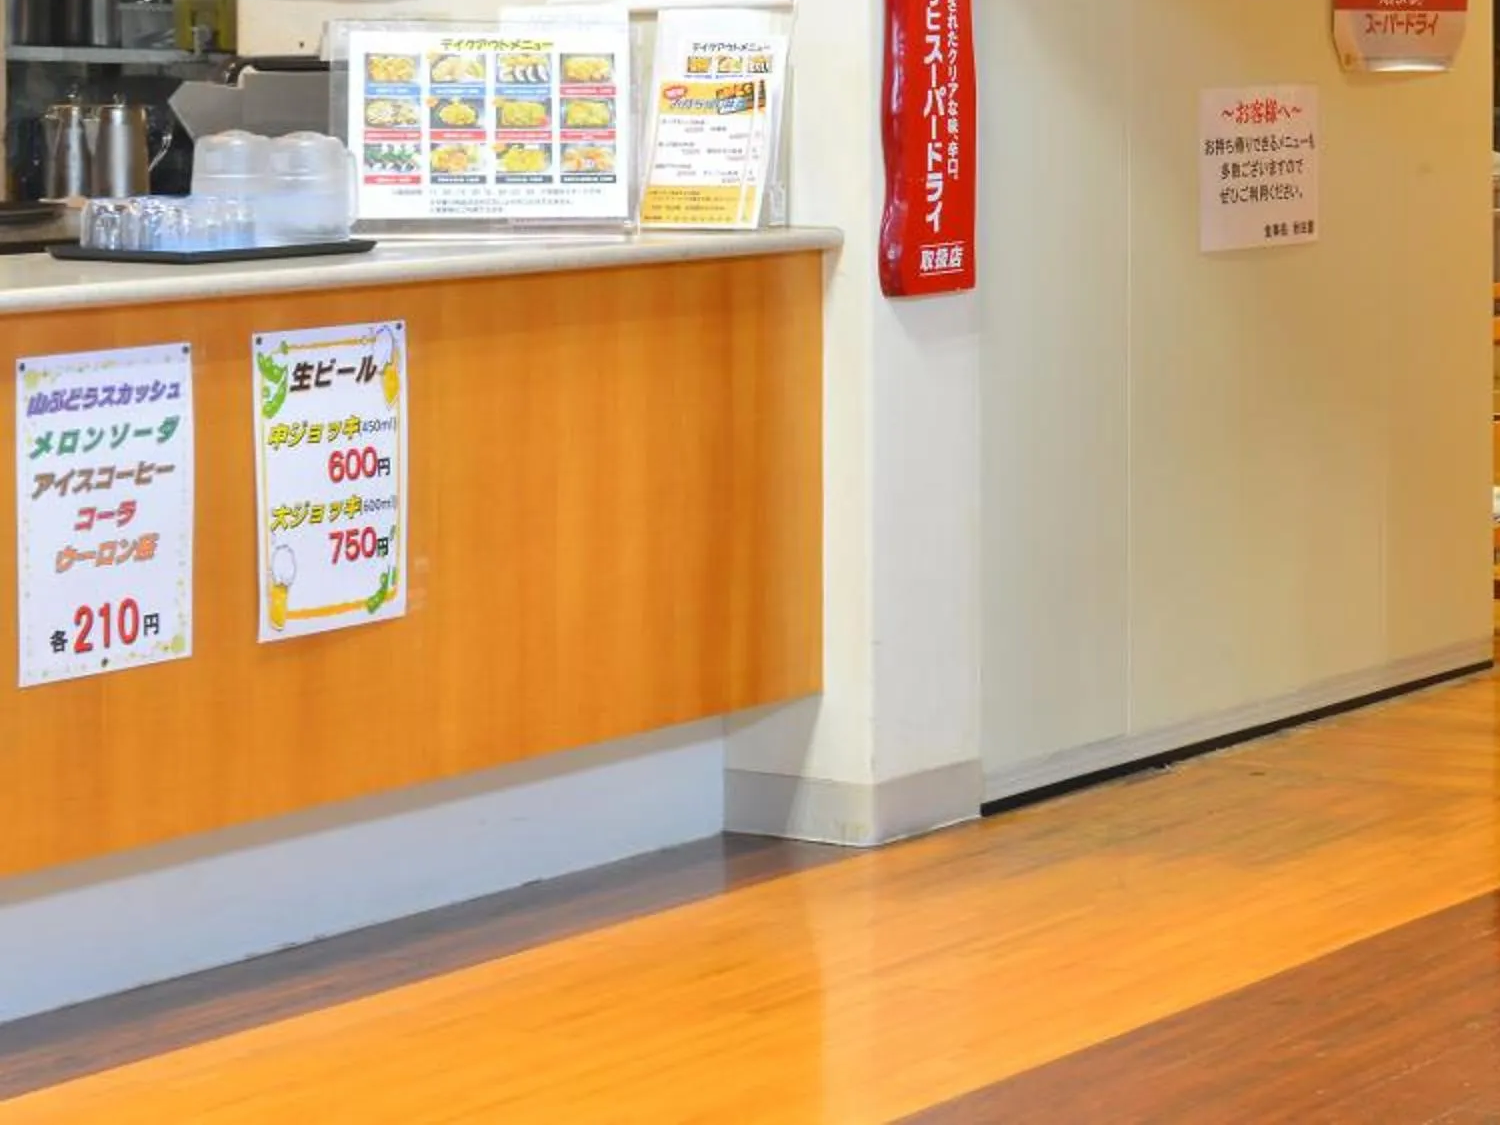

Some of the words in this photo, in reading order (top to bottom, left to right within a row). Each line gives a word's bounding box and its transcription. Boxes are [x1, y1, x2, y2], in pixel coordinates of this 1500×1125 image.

[1365, 14, 1438, 36] スーパードライ
[920, 246, 964, 271] 取扱店
[289, 355, 378, 392] 生ビール
[27, 381, 181, 417] 山ぶどうスカッシュ
[30, 416, 181, 459] メロンソーダ
[32, 460, 175, 499] アイスコーヒー
[327, 446, 390, 483] 600円
[74, 500, 136, 531] コーラ
[55, 533, 159, 574] ウーロン茶
[329, 527, 390, 565] 750円
